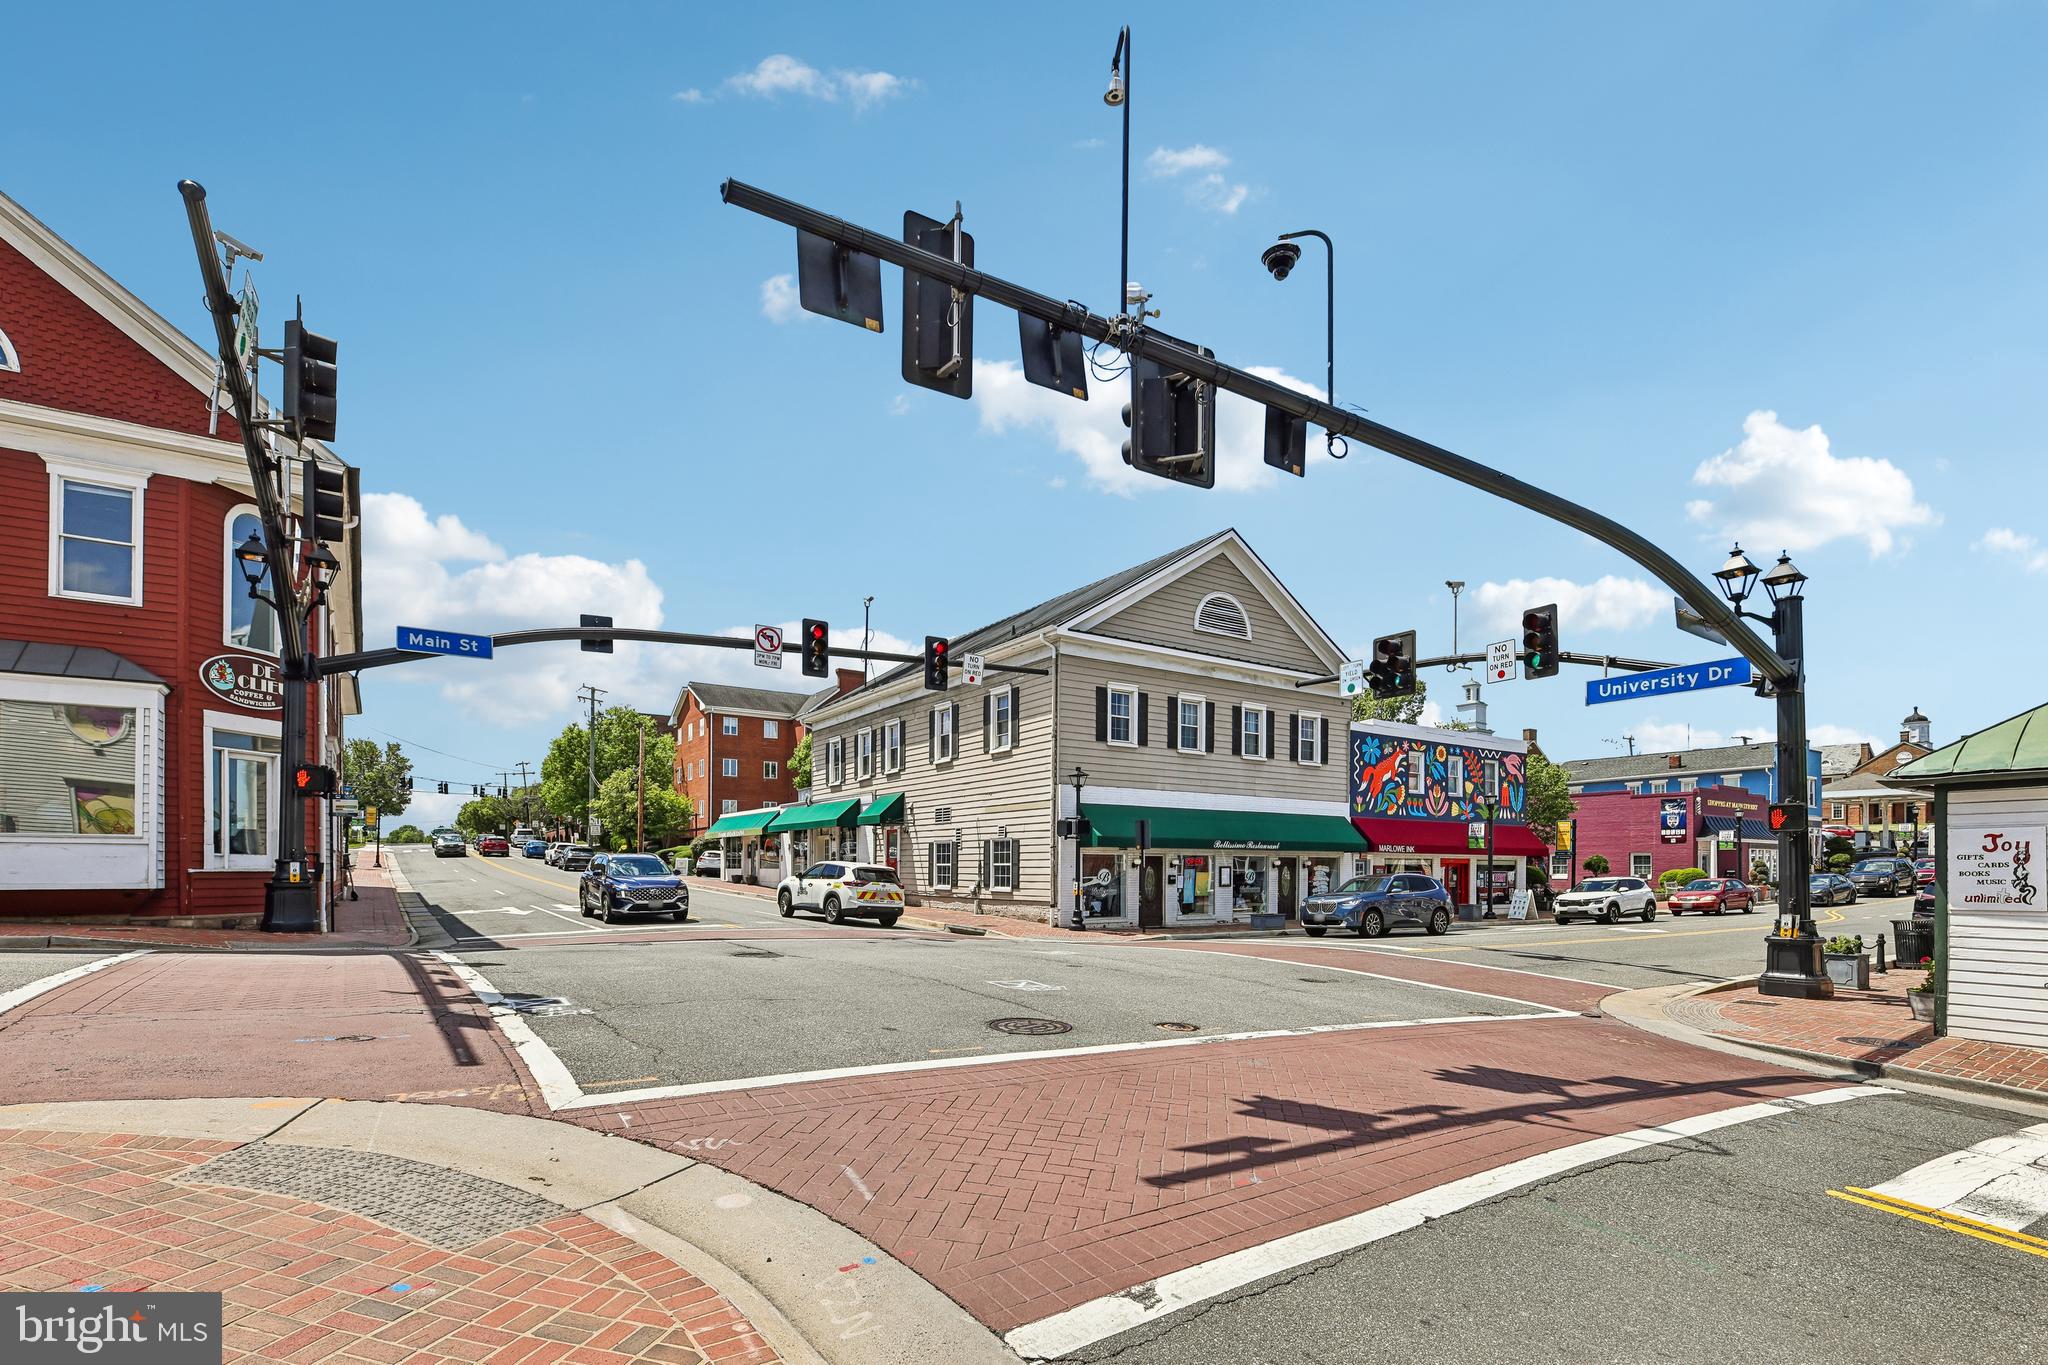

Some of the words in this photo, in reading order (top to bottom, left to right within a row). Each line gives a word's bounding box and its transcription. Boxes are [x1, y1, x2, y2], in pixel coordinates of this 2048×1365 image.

[409, 632, 450, 649] Main
[459, 638, 478, 652] St
[1494, 643, 1507, 654] NO
[1493, 653, 1510, 662] TURN
[252, 663, 276, 680] DE
[1489, 664, 1499, 672] ON
[1500, 660, 1513, 669] RED
[1600, 671, 1699, 697] University
[1708, 666, 1733, 682] Dr
[229, 693, 276, 707] SANDWICHES
[233, 688, 264, 701] COFFEE
[1246, 840, 1280, 850] Restaurant
[1378, 844, 1406, 853] MARLOWE
[1406, 845, 1415, 853] INK
[1982, 833, 2031, 865] Joy
[1977, 861, 2010, 869] CARDS
[1964, 888, 2023, 904] unlimited
